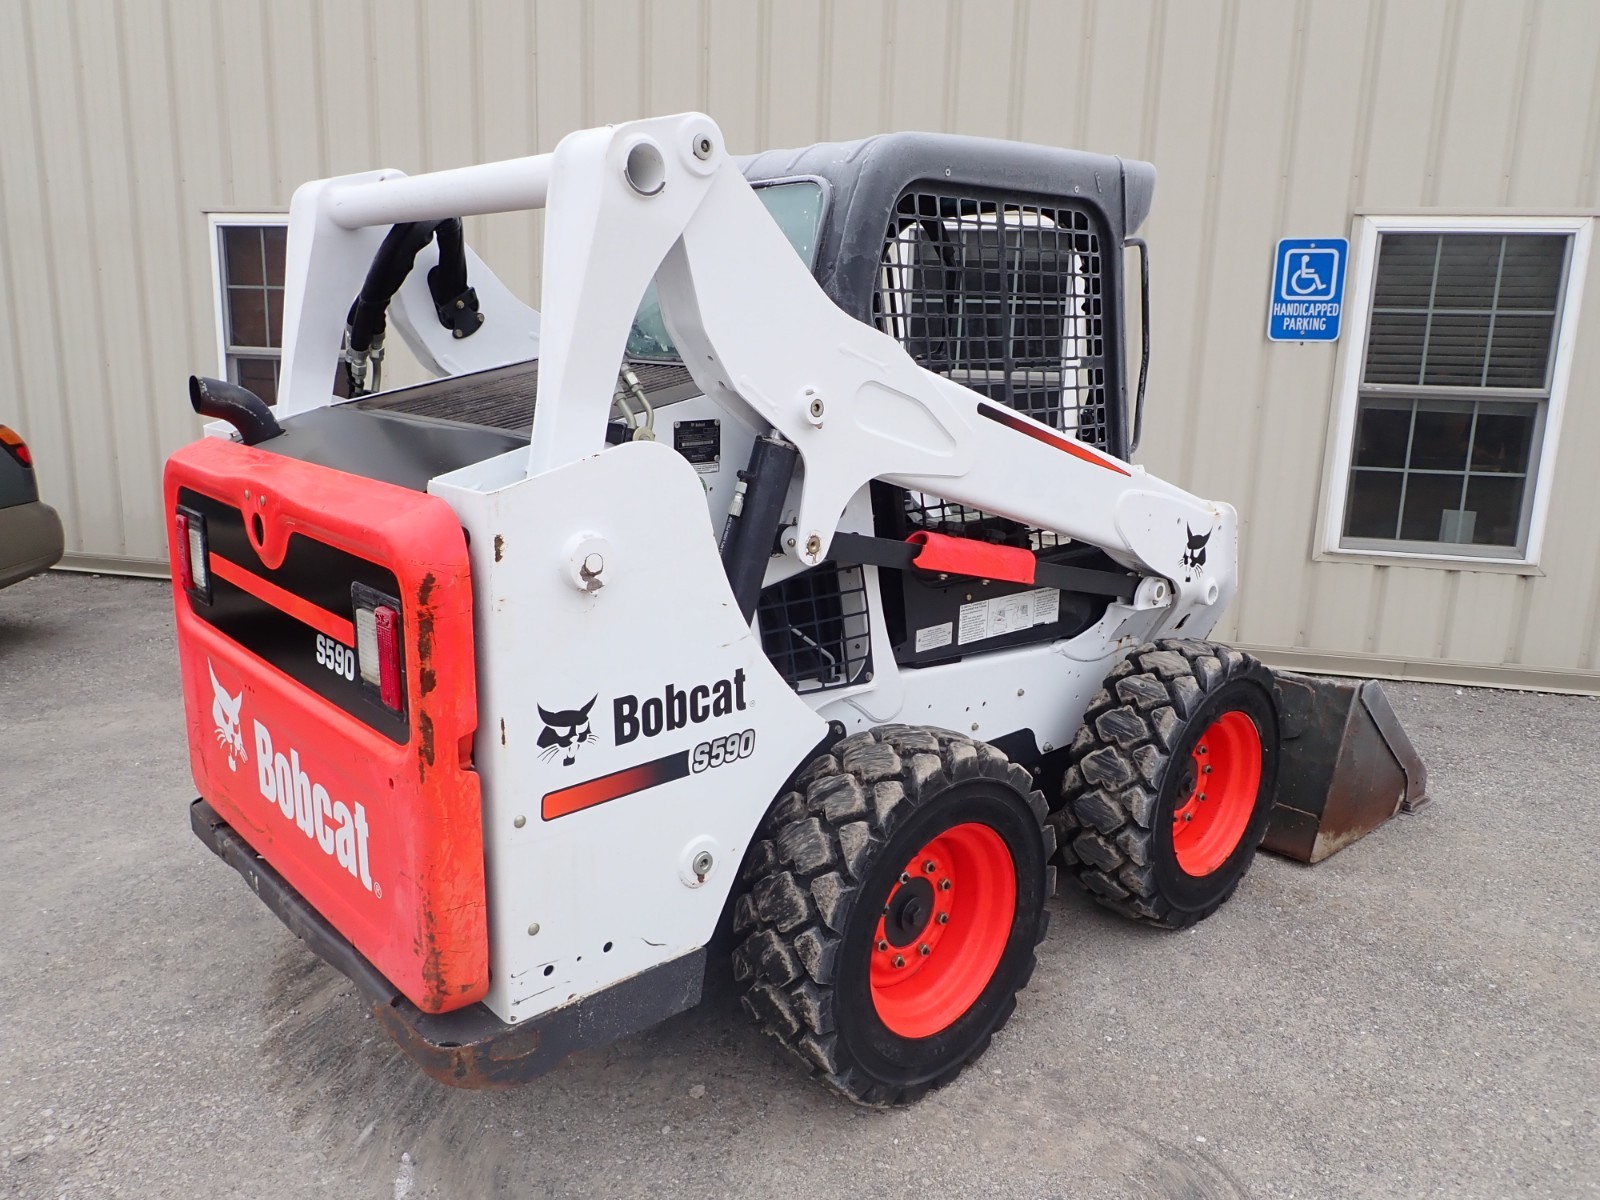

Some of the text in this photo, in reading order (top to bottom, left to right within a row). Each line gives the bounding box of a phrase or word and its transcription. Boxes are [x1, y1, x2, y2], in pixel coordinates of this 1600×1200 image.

[1273, 303, 1339, 317] HANDICAPPED
[1283, 317, 1327, 331] PARKING
[316, 633, 355, 681] S590
[613, 668, 747, 747] Bobcat
[692, 728, 756, 774] S590
[253, 718, 373, 892] Bobcat
